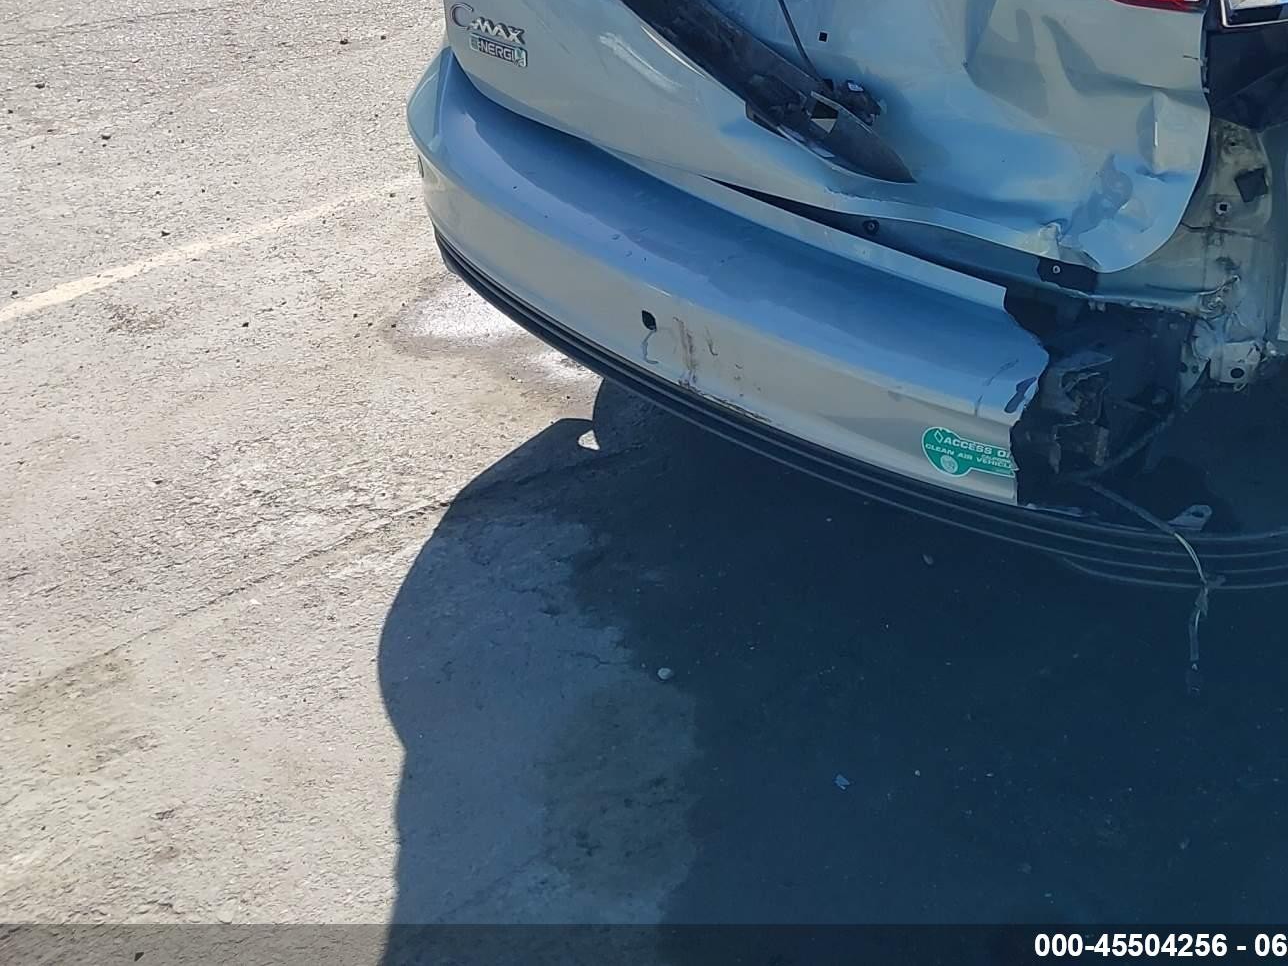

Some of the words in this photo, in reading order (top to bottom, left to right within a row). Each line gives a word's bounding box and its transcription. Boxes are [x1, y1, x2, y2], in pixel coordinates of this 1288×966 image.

[925, 443, 955, 456] CLEAN
[957, 452, 973, 461] AIR
[943, 437, 993, 455] ACCESS
